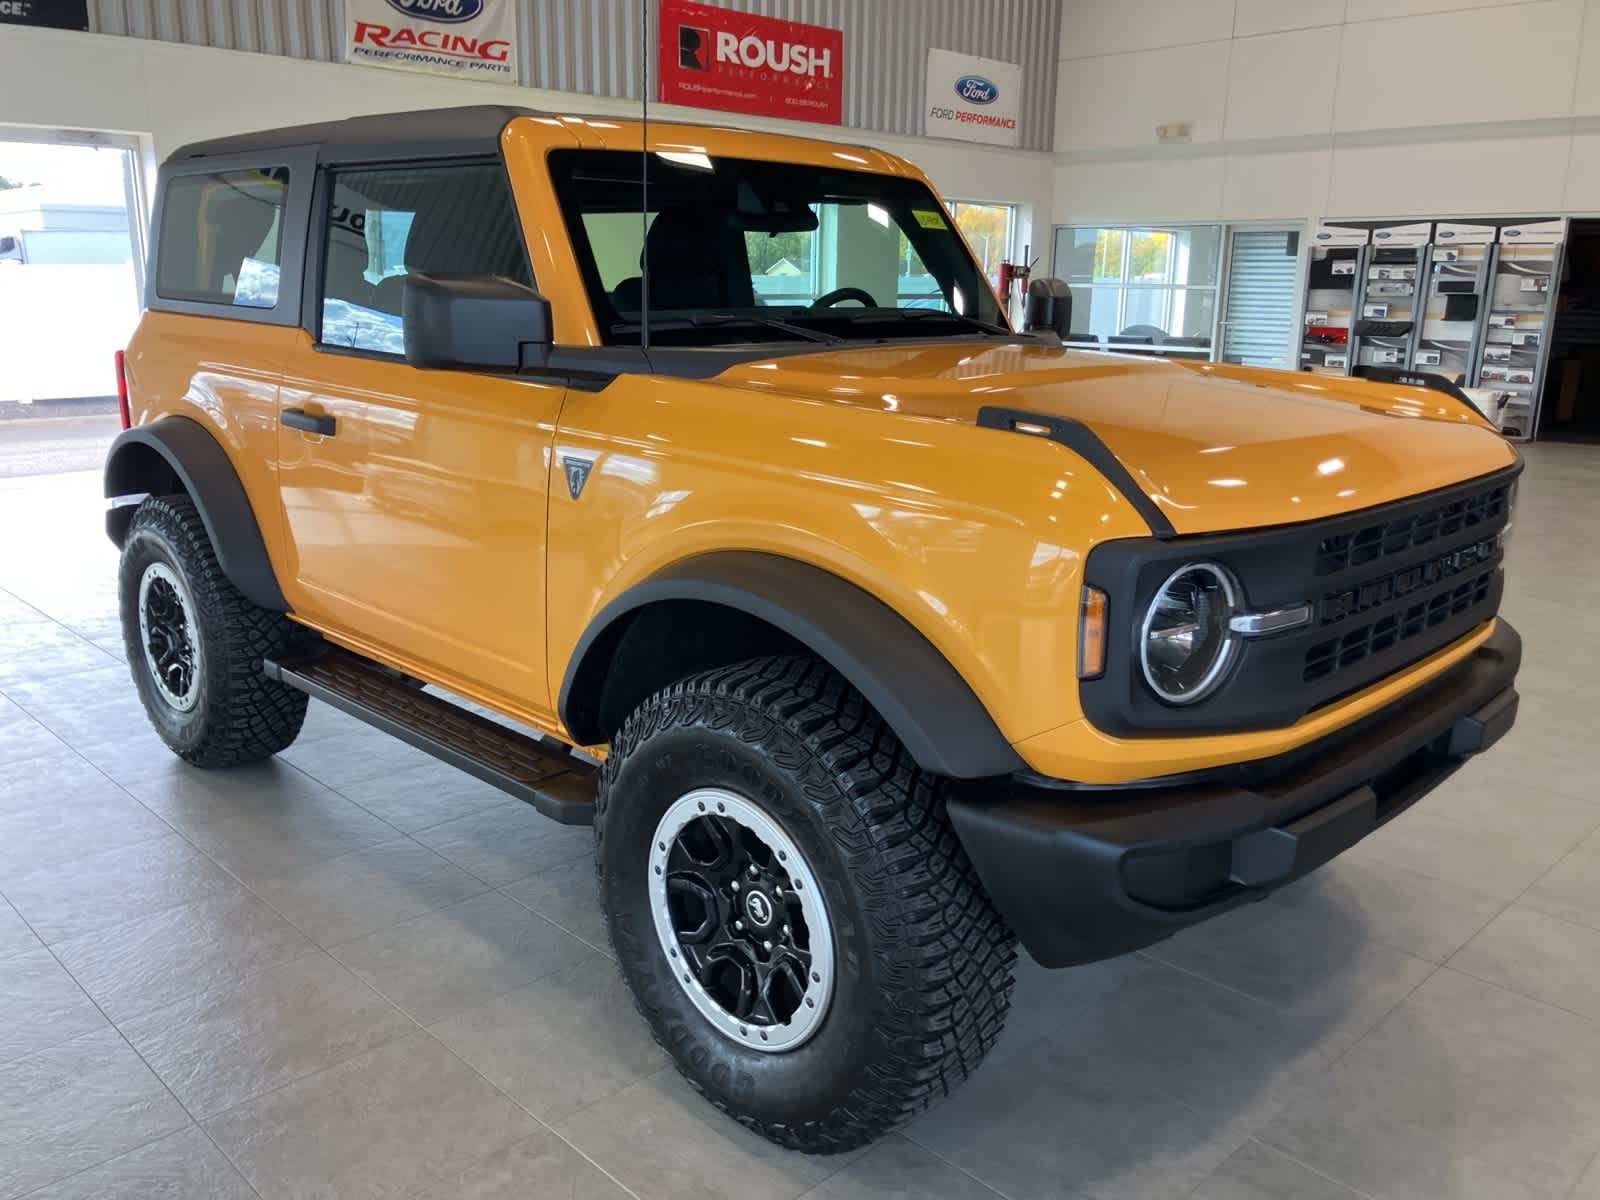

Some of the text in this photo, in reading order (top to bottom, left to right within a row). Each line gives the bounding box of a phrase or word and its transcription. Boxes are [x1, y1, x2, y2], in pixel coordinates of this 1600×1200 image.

[353, 20, 511, 61] RACING
[354, 47, 512, 73] PERFORMANCE PARTS
[716, 31, 831, 78] ROUSH
[962, 79, 991, 101] Ford
[930, 107, 1017, 129] FORD PERFORMANCE
